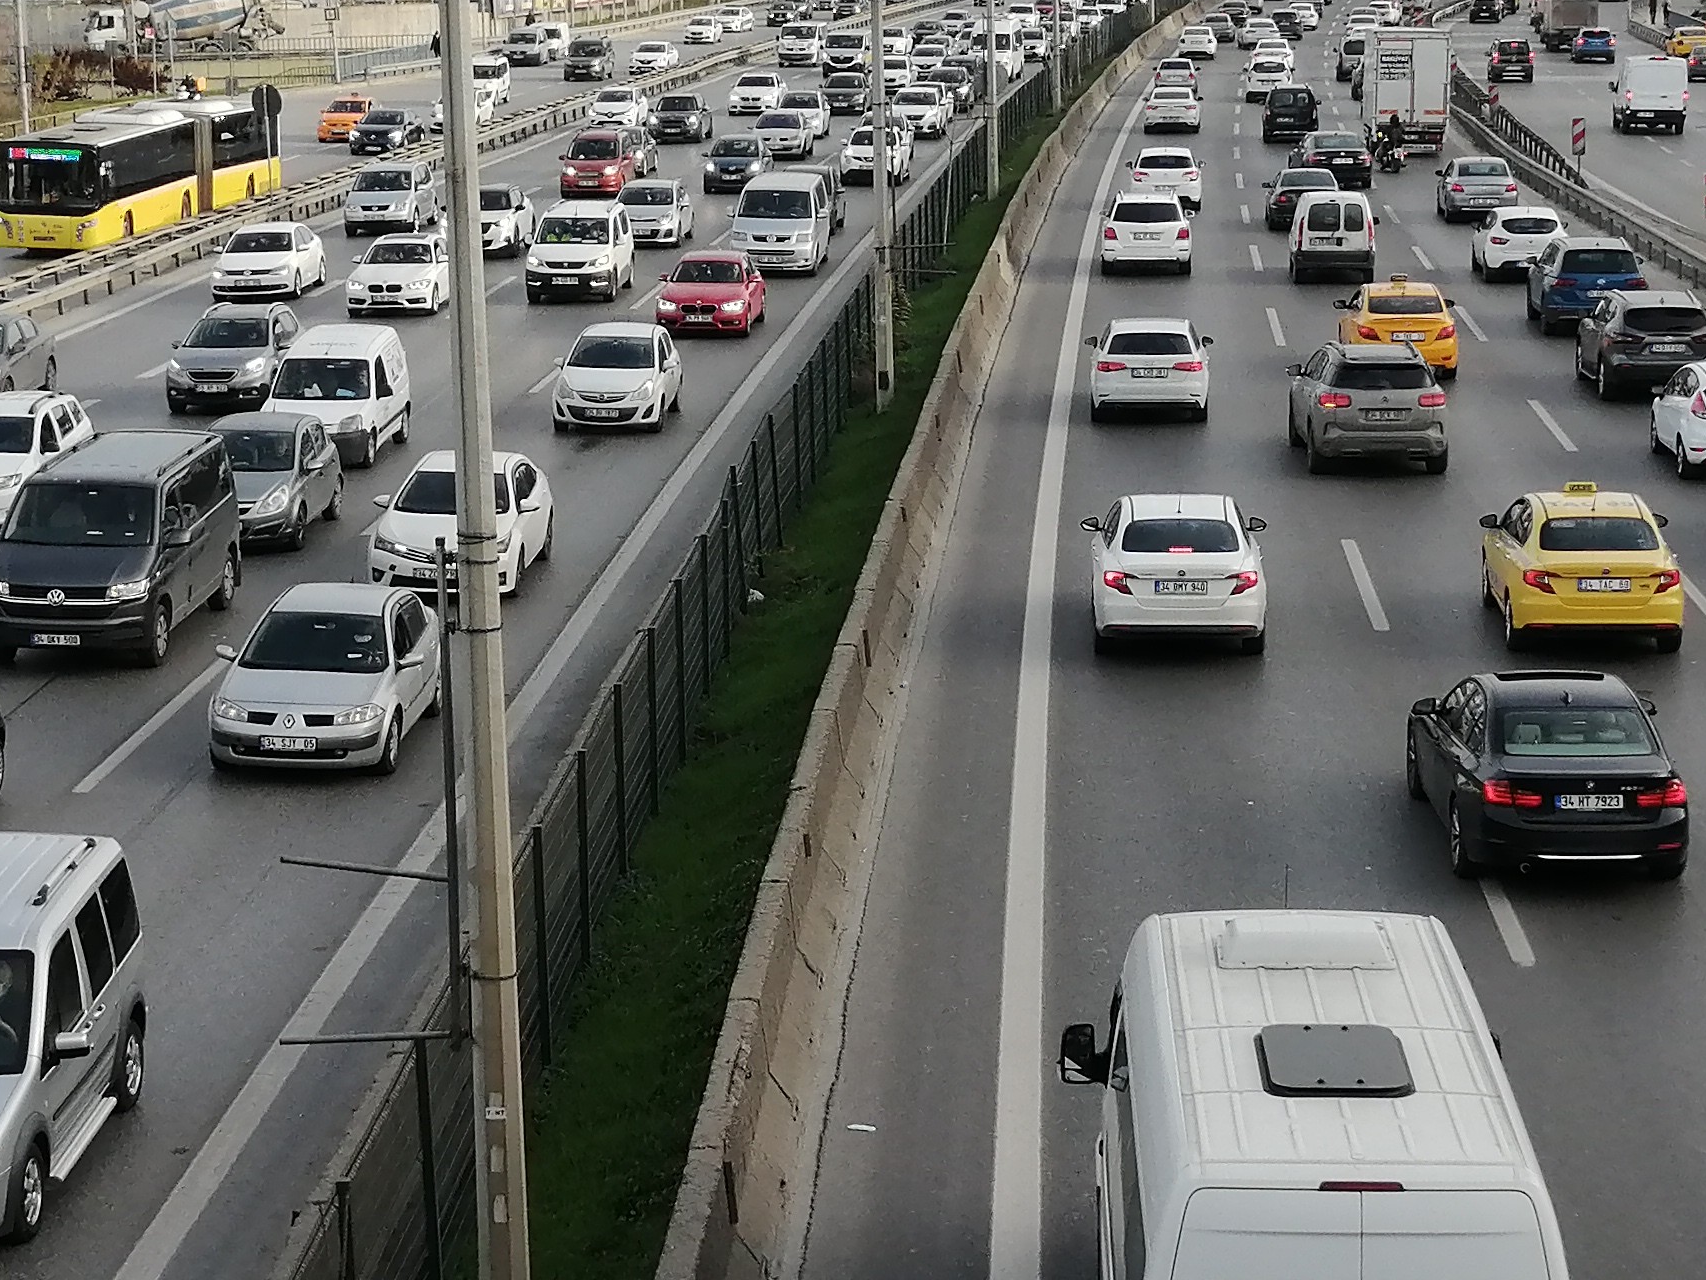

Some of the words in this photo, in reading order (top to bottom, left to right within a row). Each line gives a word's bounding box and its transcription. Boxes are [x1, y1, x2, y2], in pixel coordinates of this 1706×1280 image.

[1160, 582, 1169, 591] 34
[266, 738, 276, 747] 34
[1561, 796, 1575, 807] 34
[1578, 795, 1591, 807] HT
[1594, 795, 1620, 807] 7923
